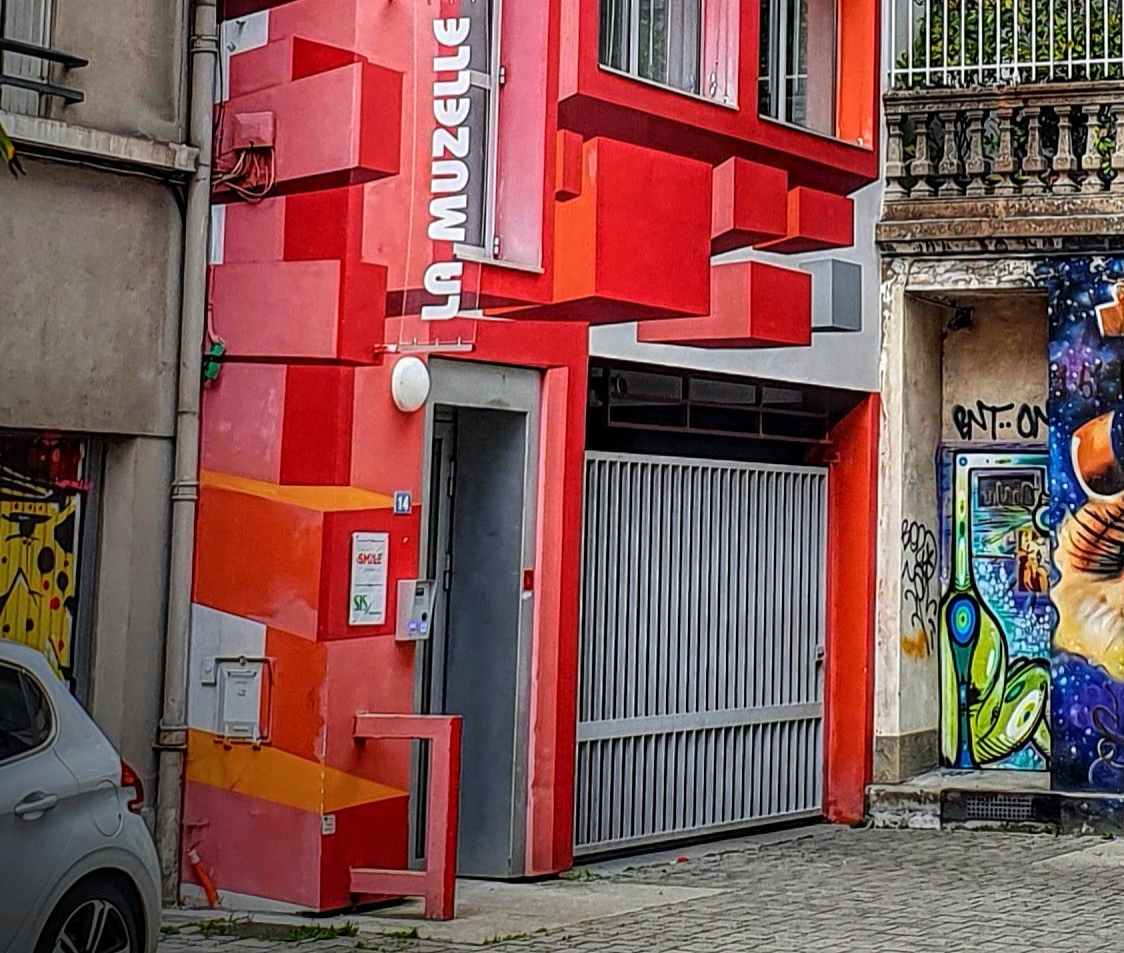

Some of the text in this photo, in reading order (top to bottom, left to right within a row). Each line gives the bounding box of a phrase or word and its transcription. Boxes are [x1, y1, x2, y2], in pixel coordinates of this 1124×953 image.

[421, 16, 471, 321] LA MUZELLE
[397, 495, 409, 511] 14
[357, 552, 382, 565] SMILE
